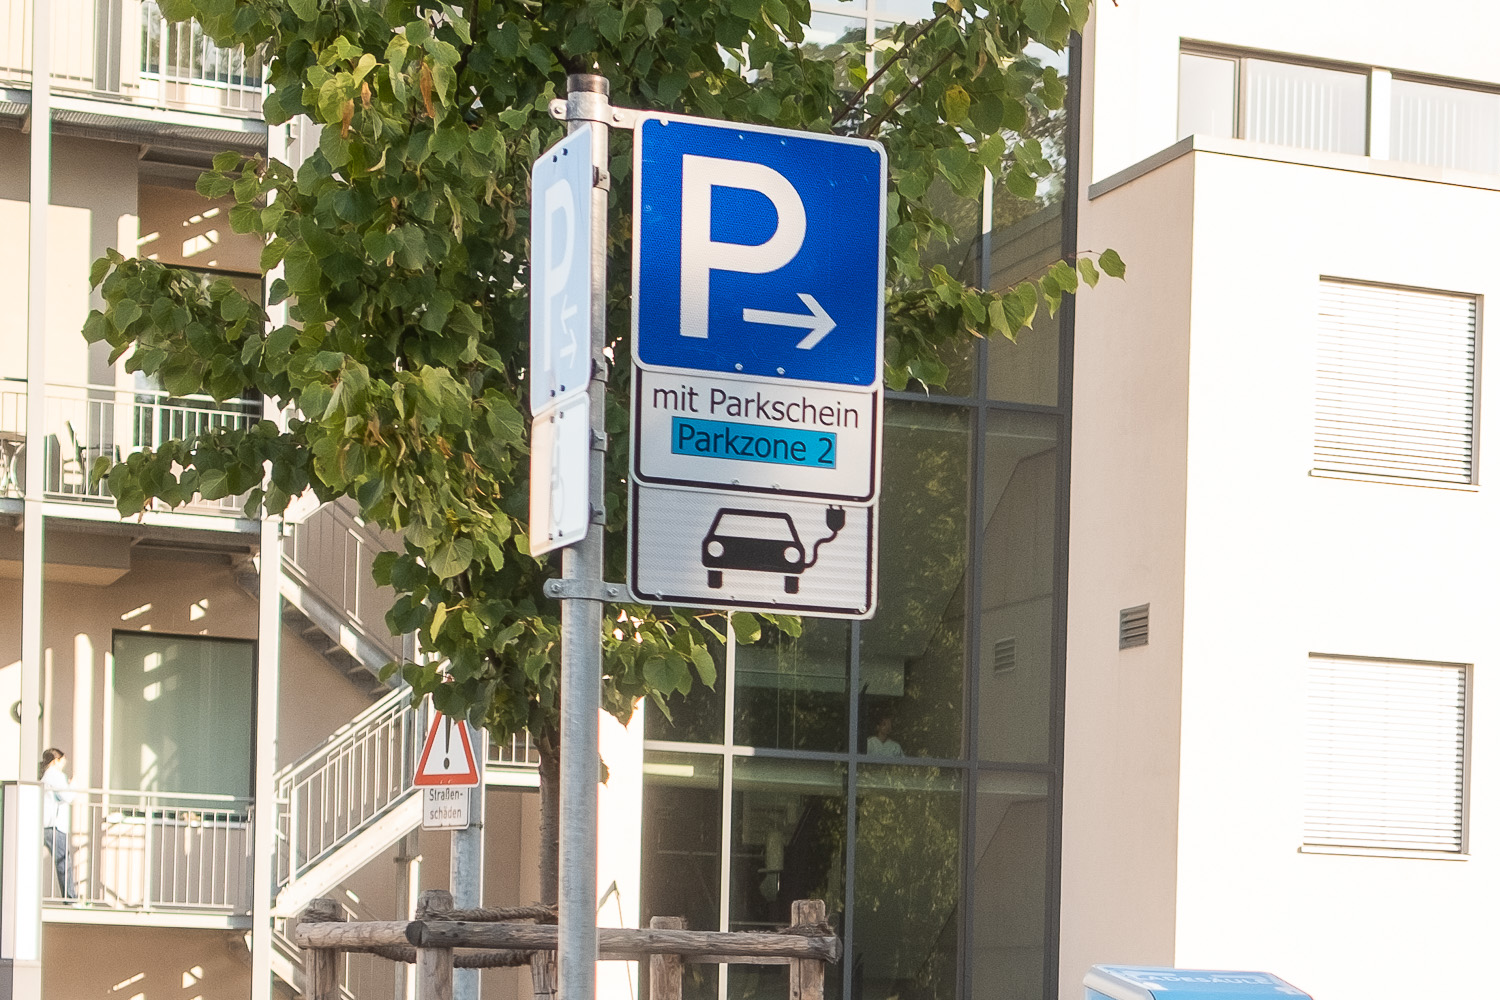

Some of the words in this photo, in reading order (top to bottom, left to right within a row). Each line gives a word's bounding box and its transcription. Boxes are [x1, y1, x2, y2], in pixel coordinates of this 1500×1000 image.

[680, 153, 807, 339] P
[653, 384, 699, 413] mit
[710, 388, 859, 429] Parkschein
[678, 423, 807, 462] Parkzone
[817, 437, 834, 464] 2
[429, 788, 463, 801] Straßen-
[430, 806, 462, 820] schäden
